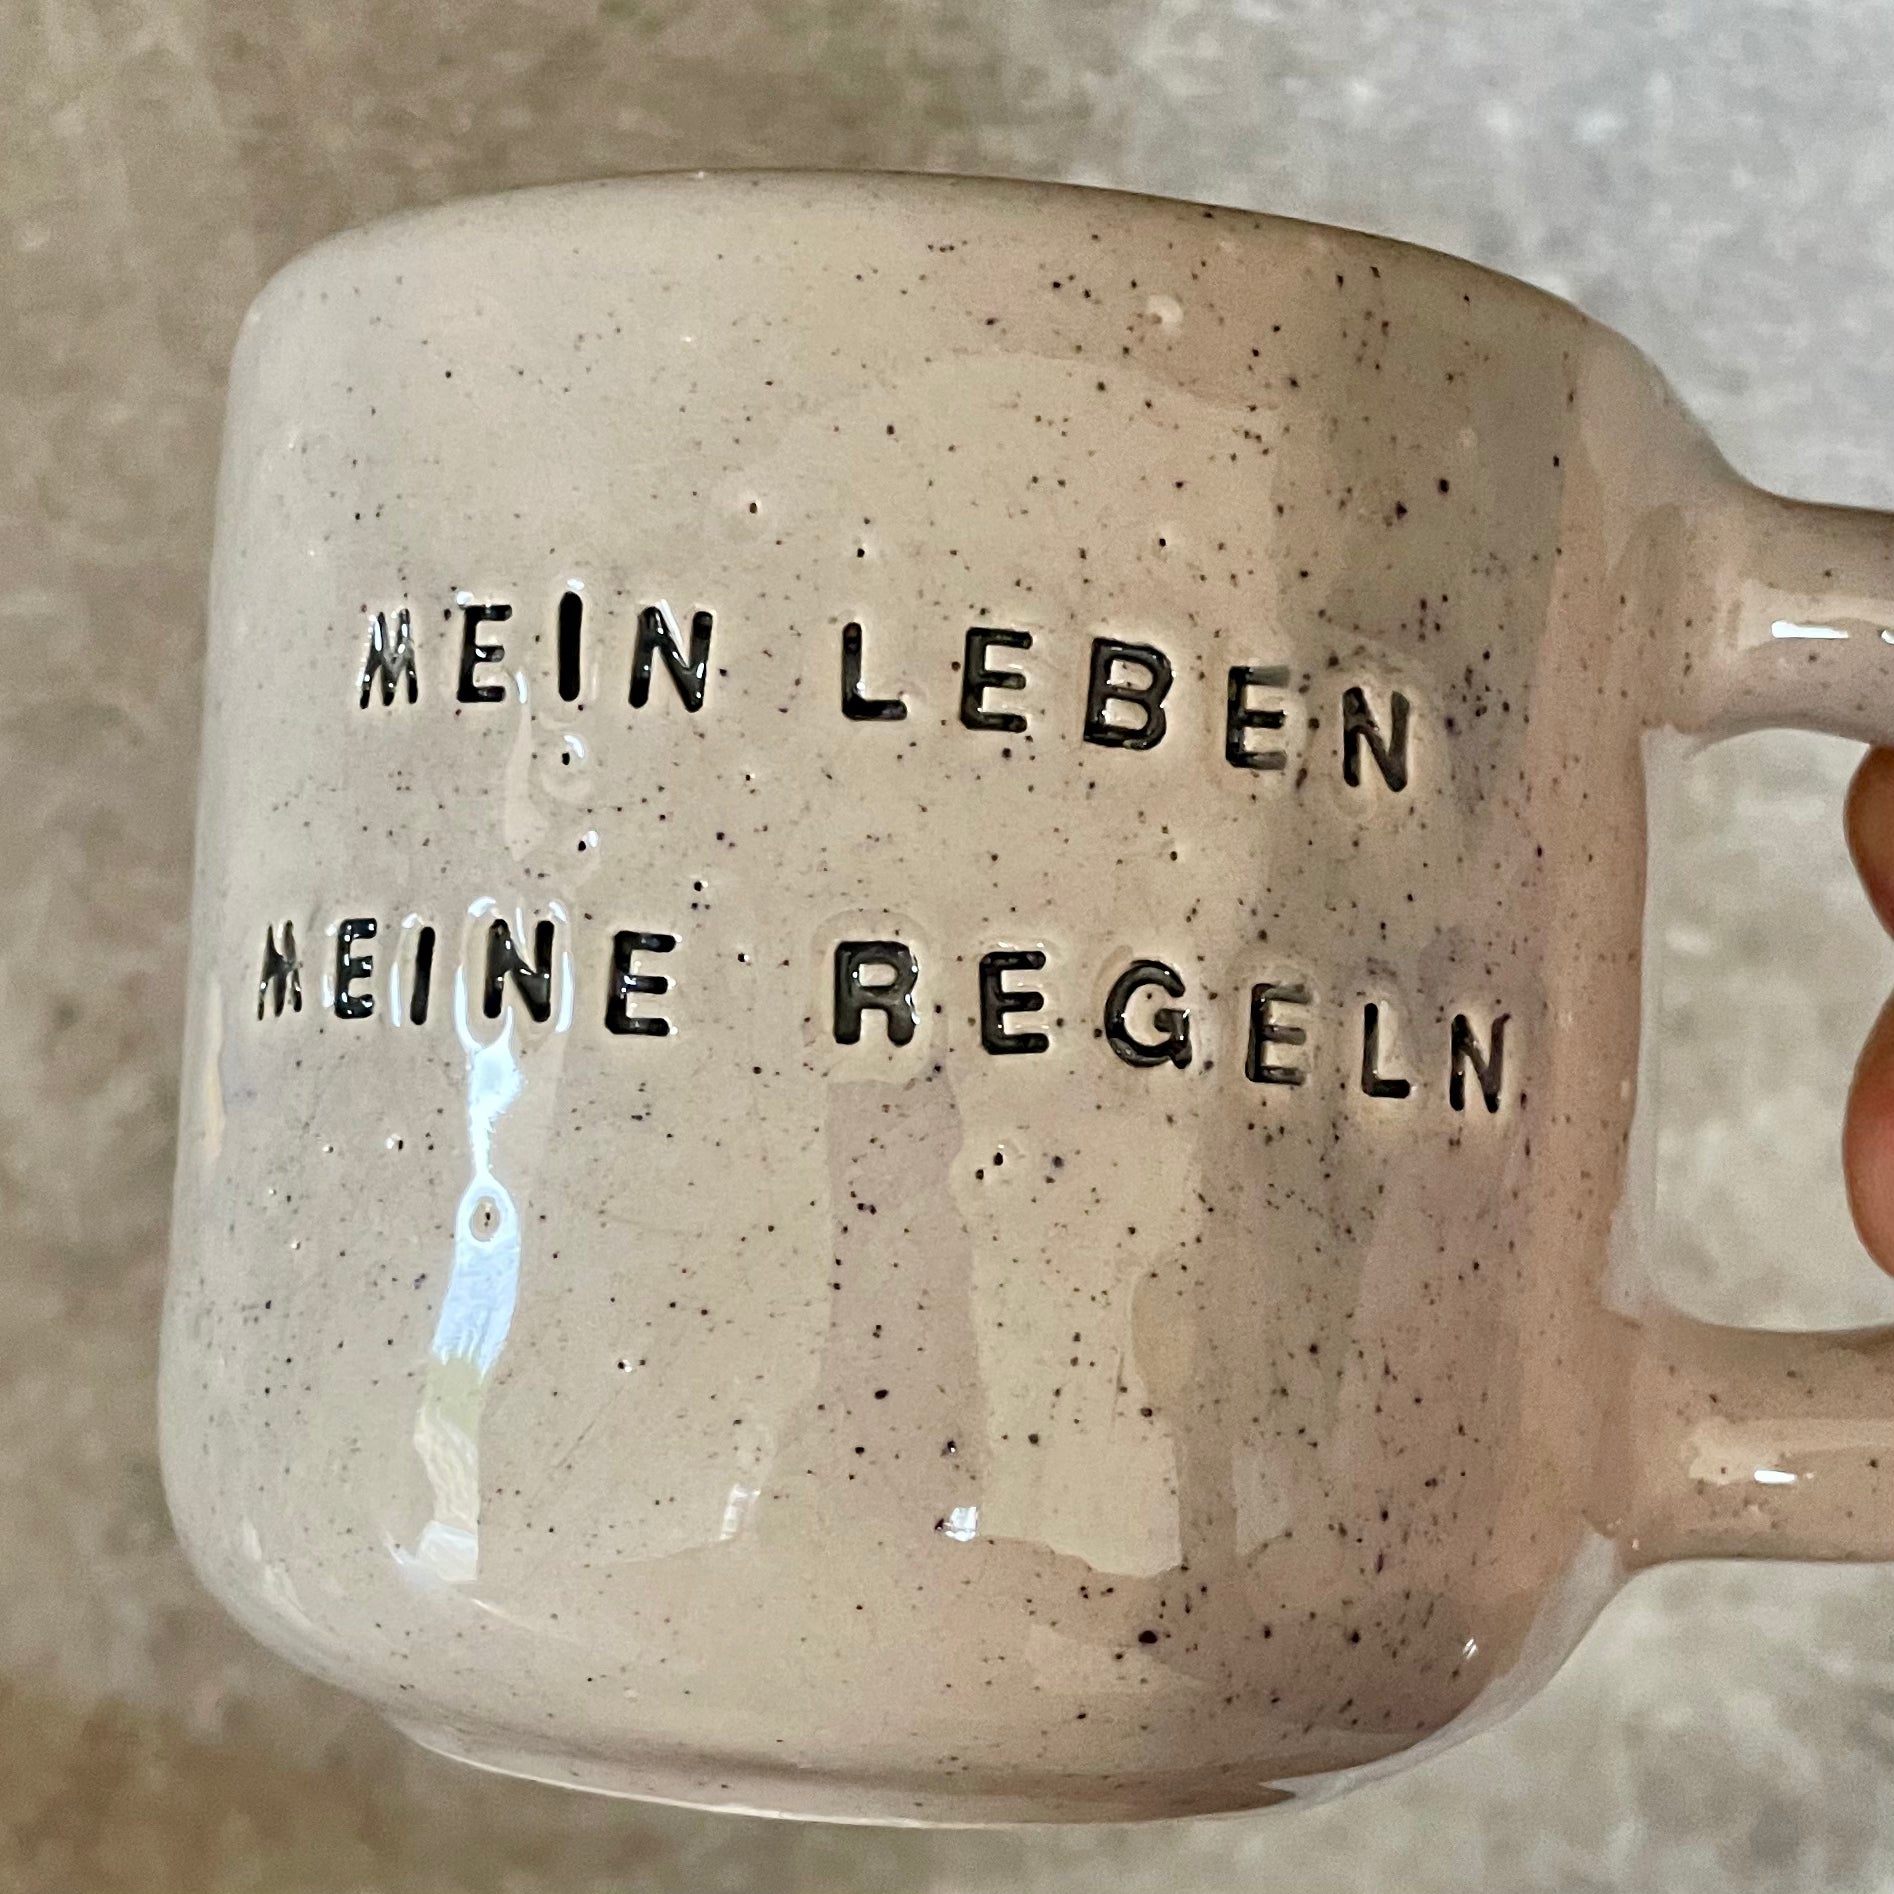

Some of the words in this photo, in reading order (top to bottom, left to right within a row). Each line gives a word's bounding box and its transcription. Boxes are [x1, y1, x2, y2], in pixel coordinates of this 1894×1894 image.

[359, 591, 713, 713] MEIN
[841, 622, 1410, 793] LEBEN
[260, 918, 677, 1037] MEINE
[833, 940, 1513, 1114] REGELN
